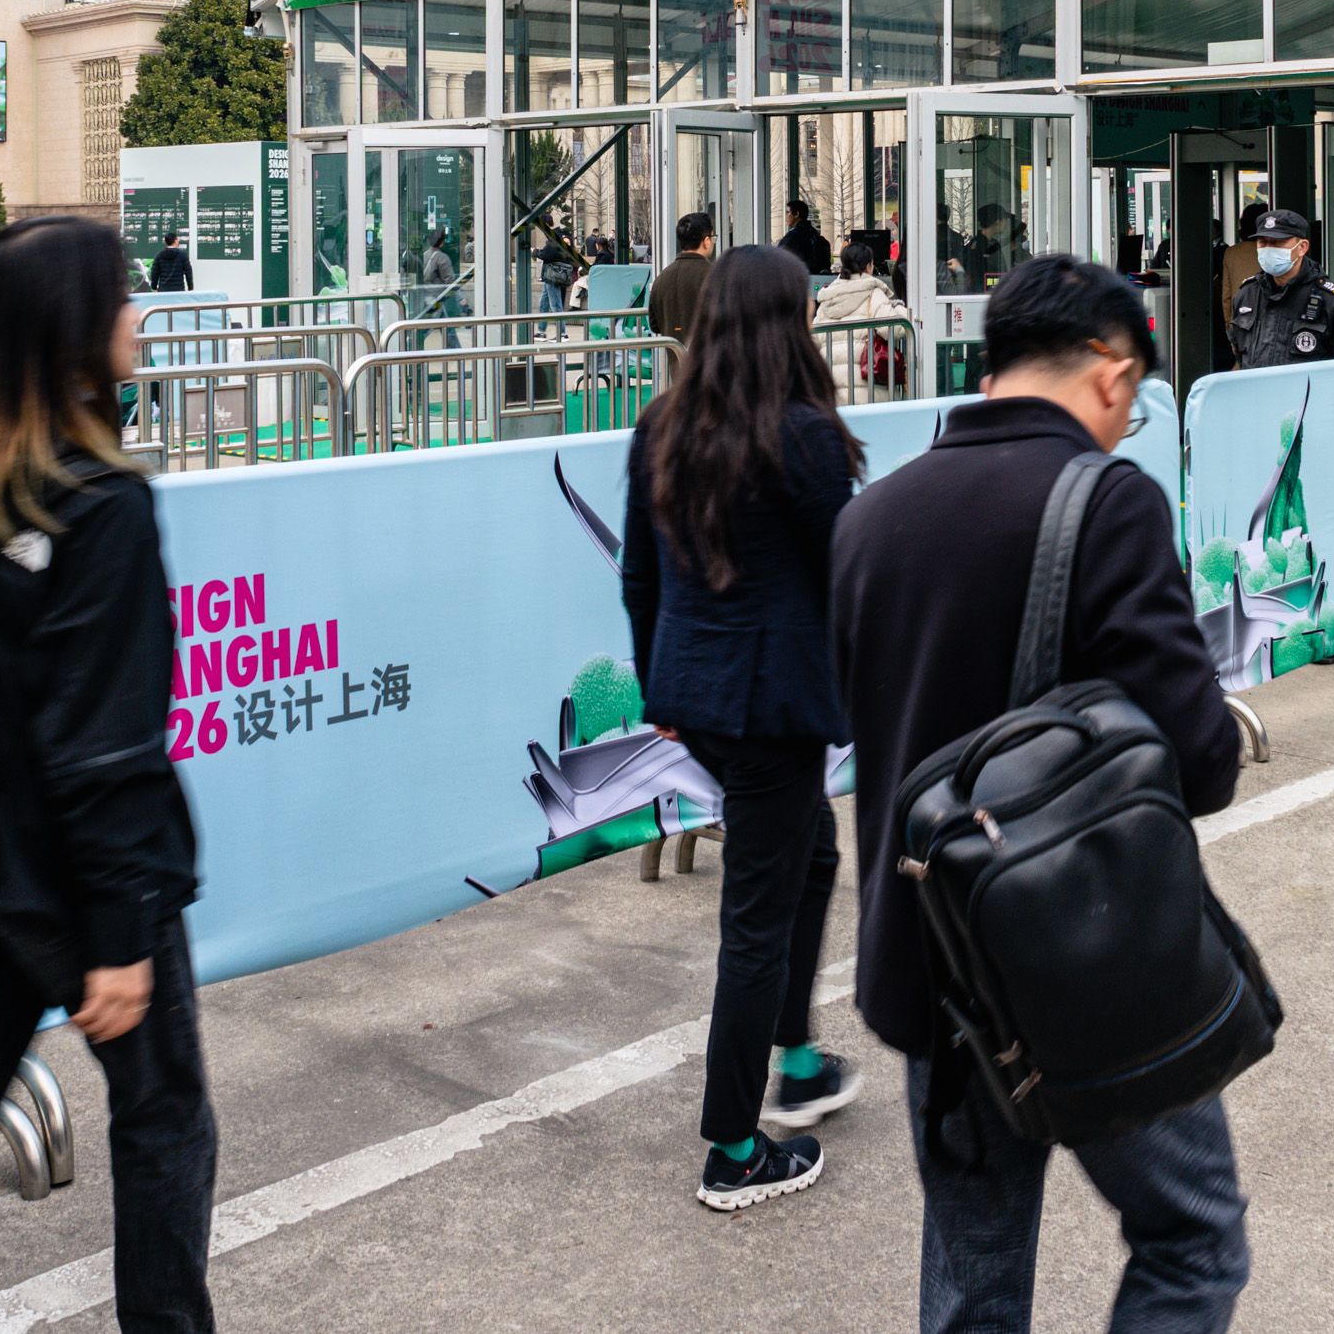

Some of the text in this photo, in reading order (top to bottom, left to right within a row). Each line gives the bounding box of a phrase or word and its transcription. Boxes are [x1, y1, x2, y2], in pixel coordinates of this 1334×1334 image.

[169, 619, 339, 701] ANGHAI
[167, 663, 412, 764] 26 设计上海
